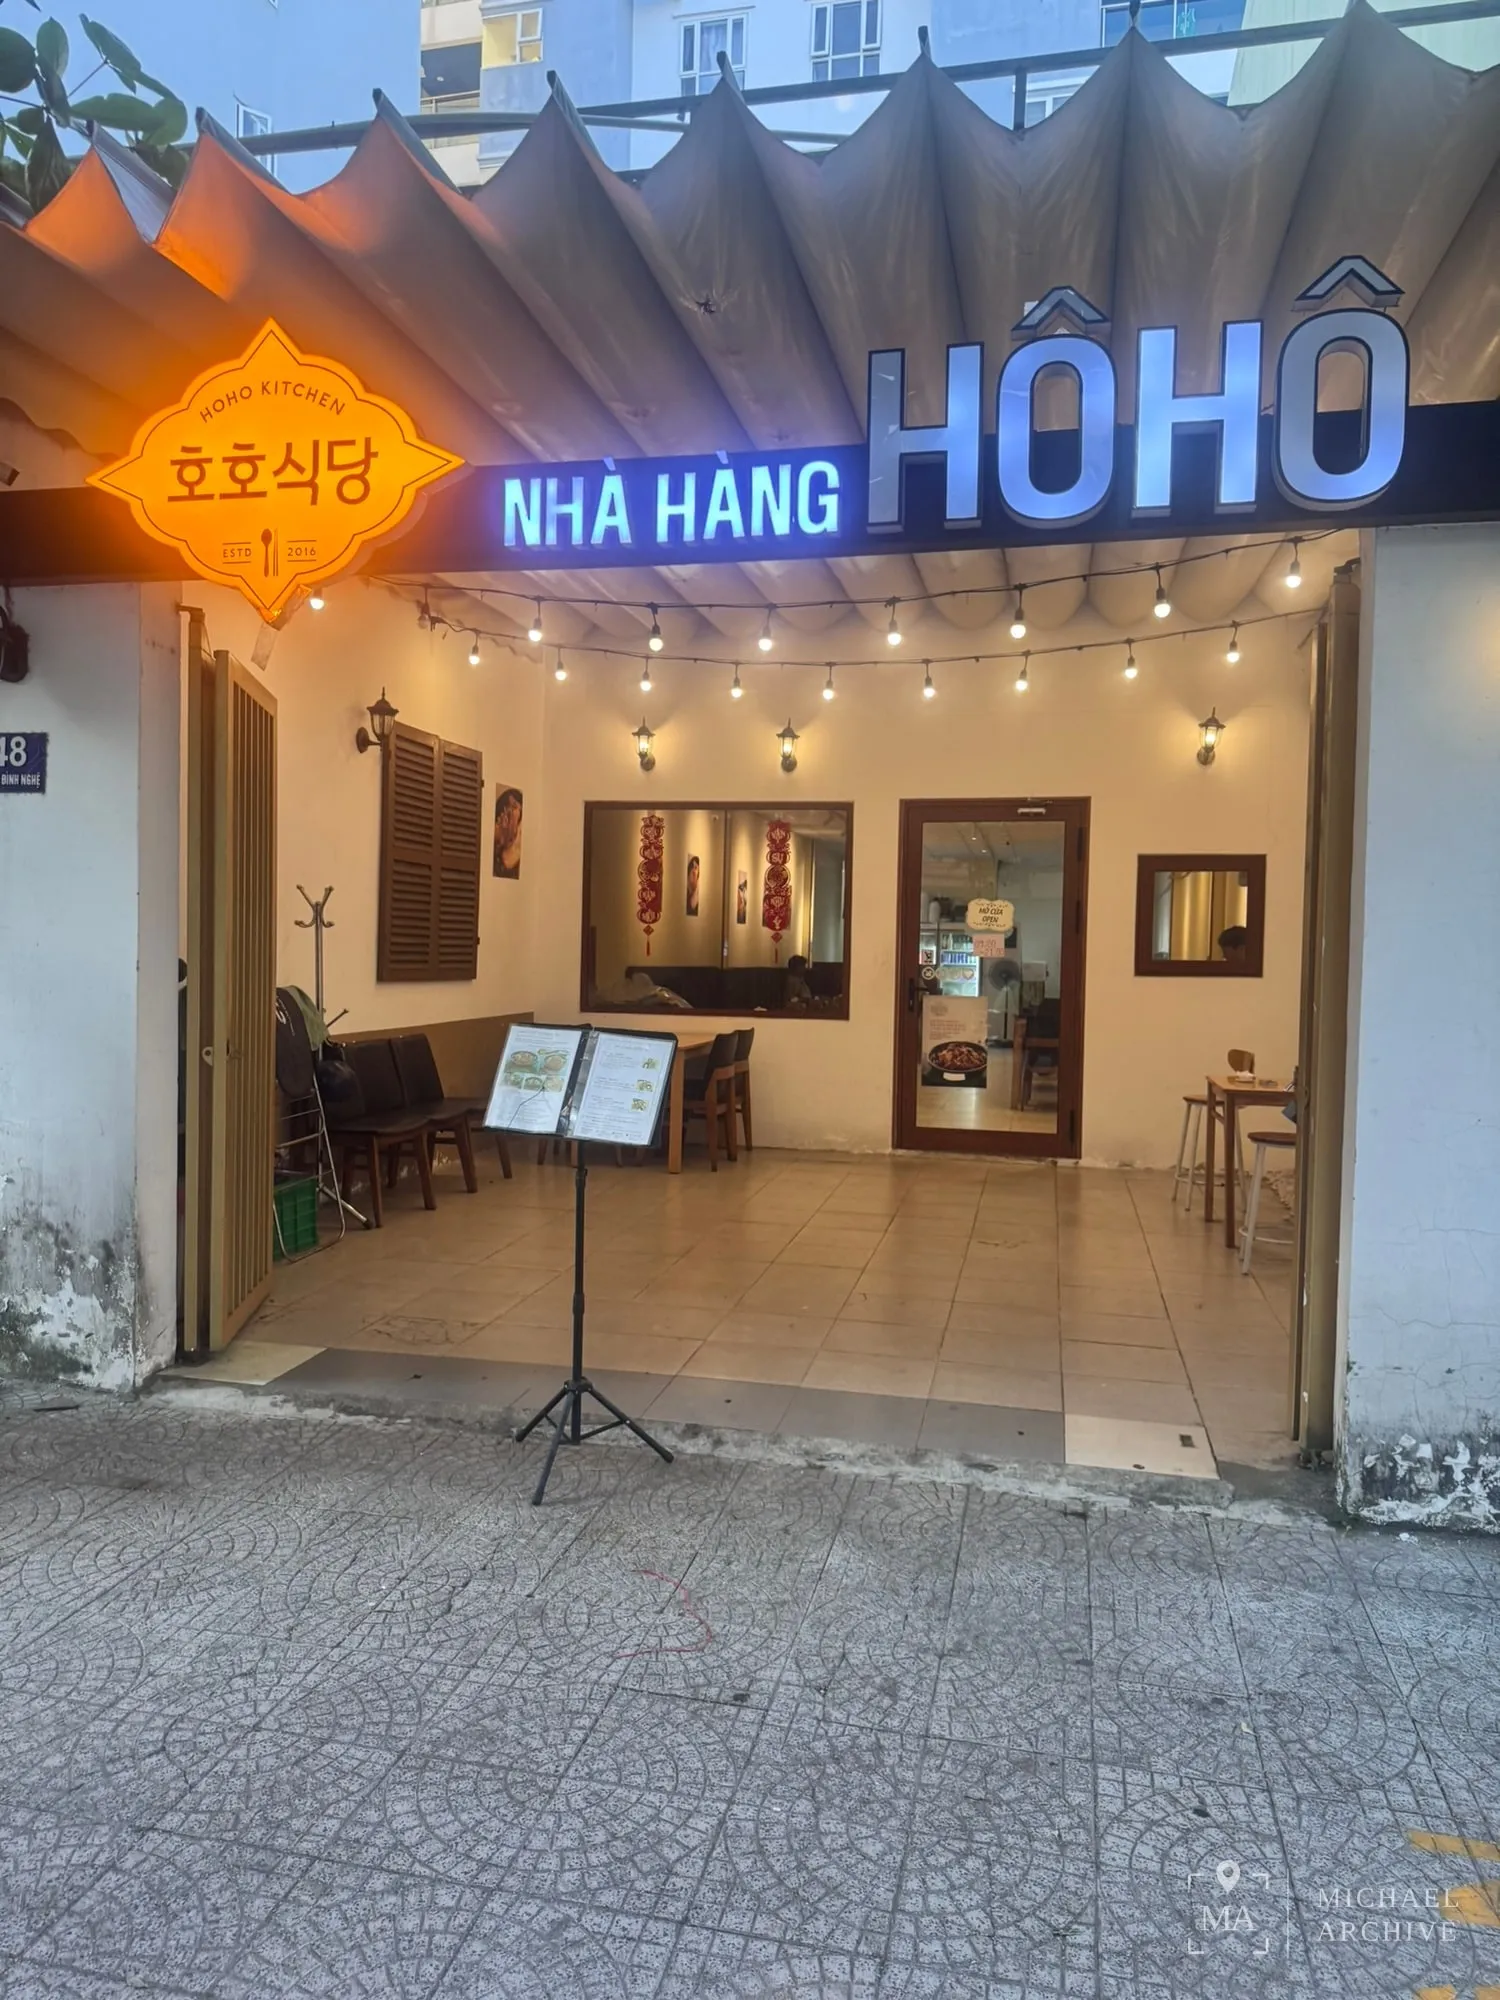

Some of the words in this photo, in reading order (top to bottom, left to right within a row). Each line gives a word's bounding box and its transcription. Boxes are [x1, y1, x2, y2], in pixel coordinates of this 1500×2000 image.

[200, 386, 253, 424] HOHO
[260, 380, 346, 416] KITCHEN
[167, 437, 379, 506] 호호식당
[504, 456, 632, 547] NHÀ
[656, 450, 840, 544] HÀNG
[222, 546, 252, 559] ESTD
[287, 545, 317, 558] 2016
[982, 915, 999, 923] OPEN
